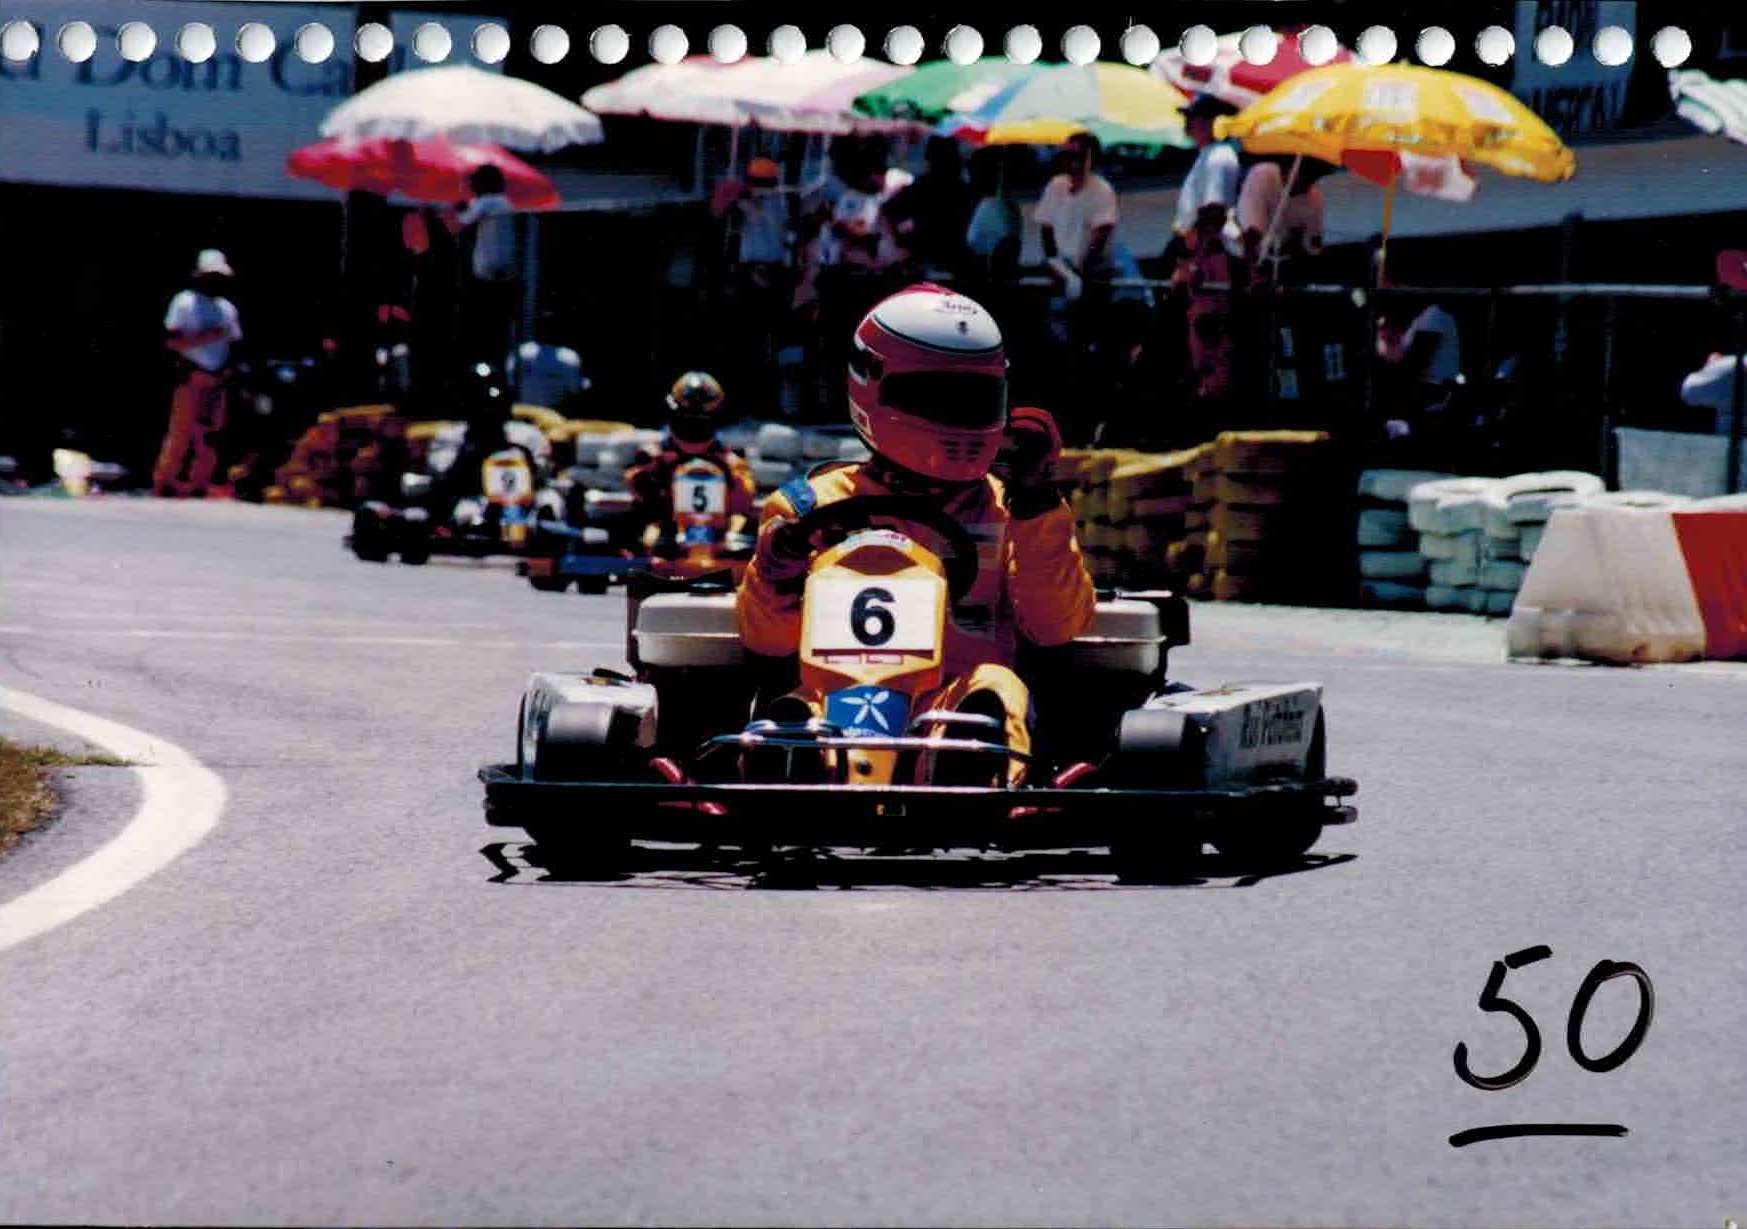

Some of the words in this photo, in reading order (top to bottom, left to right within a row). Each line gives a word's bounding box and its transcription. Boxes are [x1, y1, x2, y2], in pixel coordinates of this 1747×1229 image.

[85, 107, 242, 161] Lisboa
[692, 485, 708, 513] 5
[851, 586, 895, 647] 6
[1453, 945, 1656, 1091] 50
